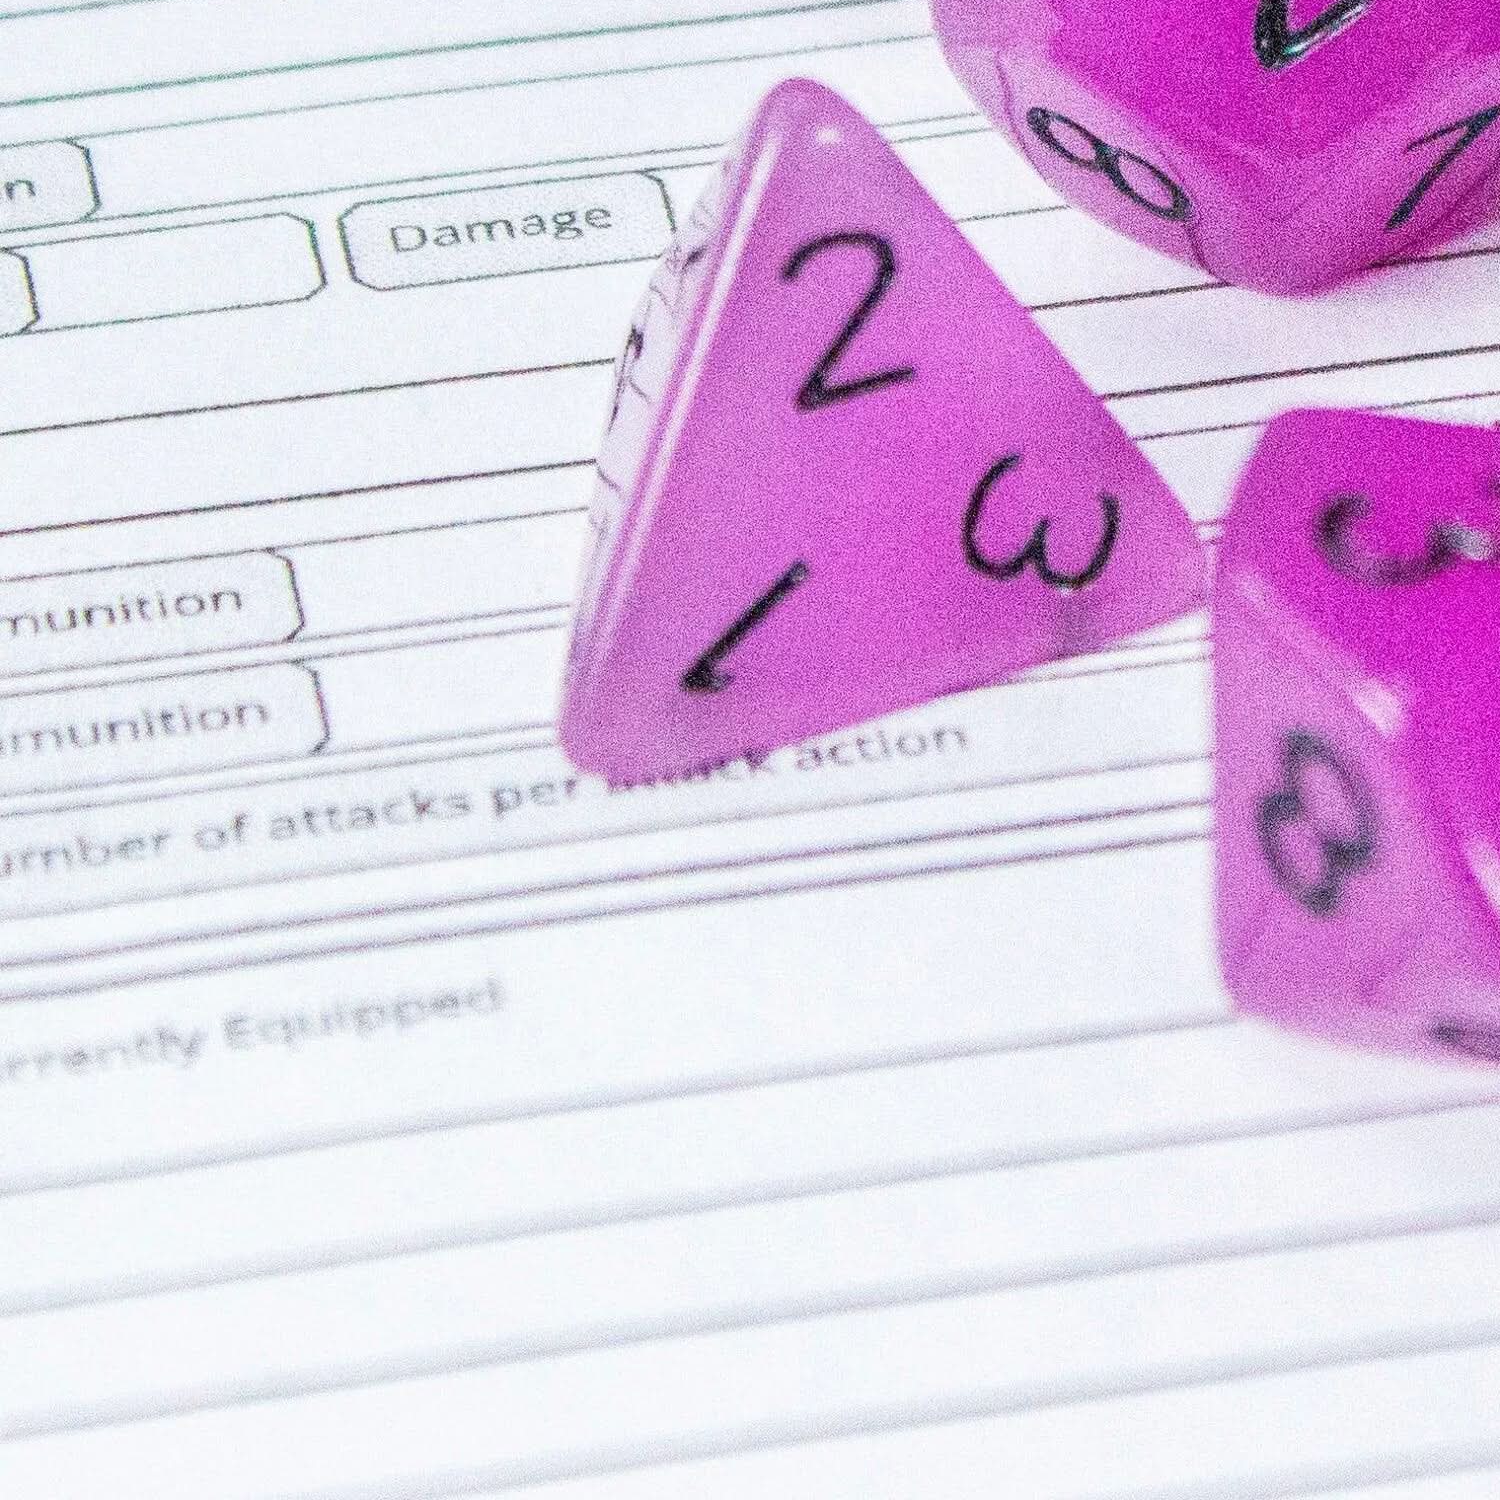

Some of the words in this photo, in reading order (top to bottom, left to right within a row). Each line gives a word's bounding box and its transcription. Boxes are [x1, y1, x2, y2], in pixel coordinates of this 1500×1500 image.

[389, 203, 612, 254] Damage
[1027, 106, 1194, 223] 8
[780, 229, 917, 414] 2
[960, 451, 1121, 590] 3
[679, 559, 810, 693] 1
[0, 698, 270, 757] munition
[194, 809, 251, 852] of
[268, 786, 474, 842] attacks
[491, 776, 578, 820] per
[795, 723, 970, 771] action
[1253, 729, 1380, 918] 8
